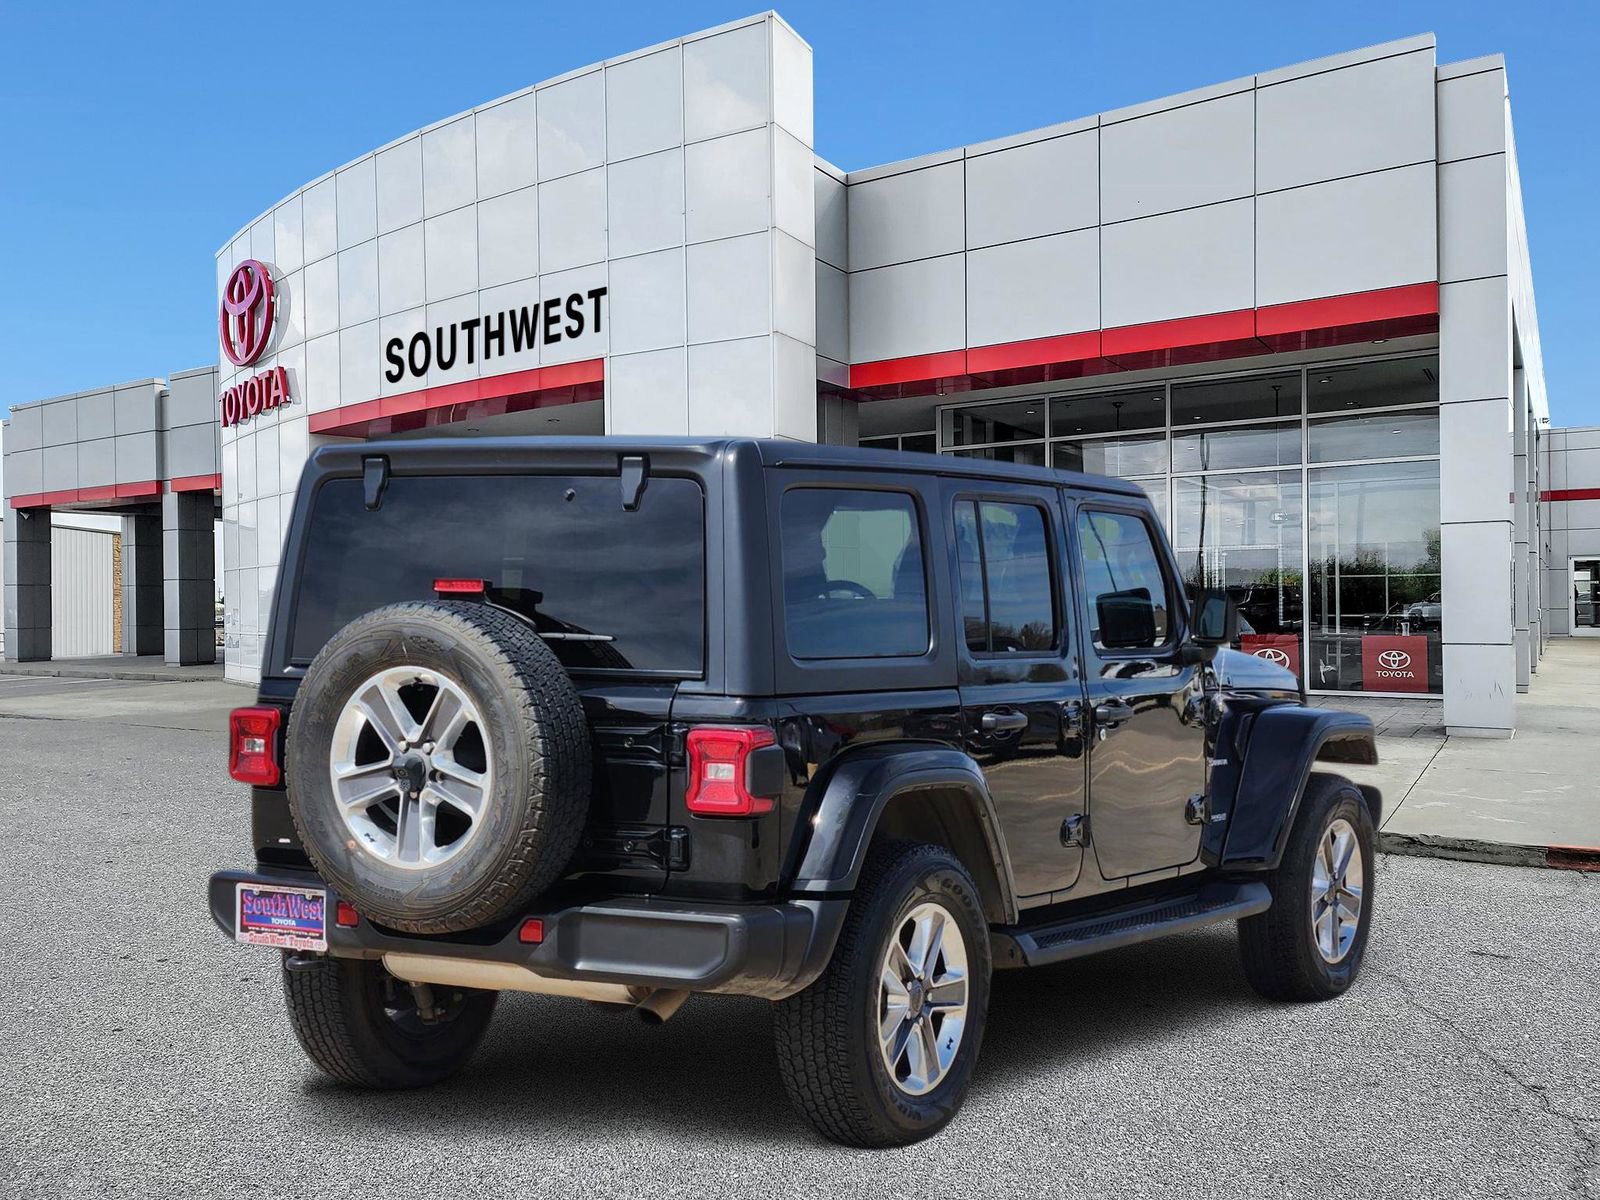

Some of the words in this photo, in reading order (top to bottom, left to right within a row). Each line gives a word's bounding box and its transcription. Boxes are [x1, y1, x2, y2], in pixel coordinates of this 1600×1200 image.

[385, 286, 607, 384] SOUTHWEST
[218, 366, 290, 427] TOYOTA
[1375, 670, 1415, 678] TOYOTA
[271, 918, 296, 926] TOYOTA
